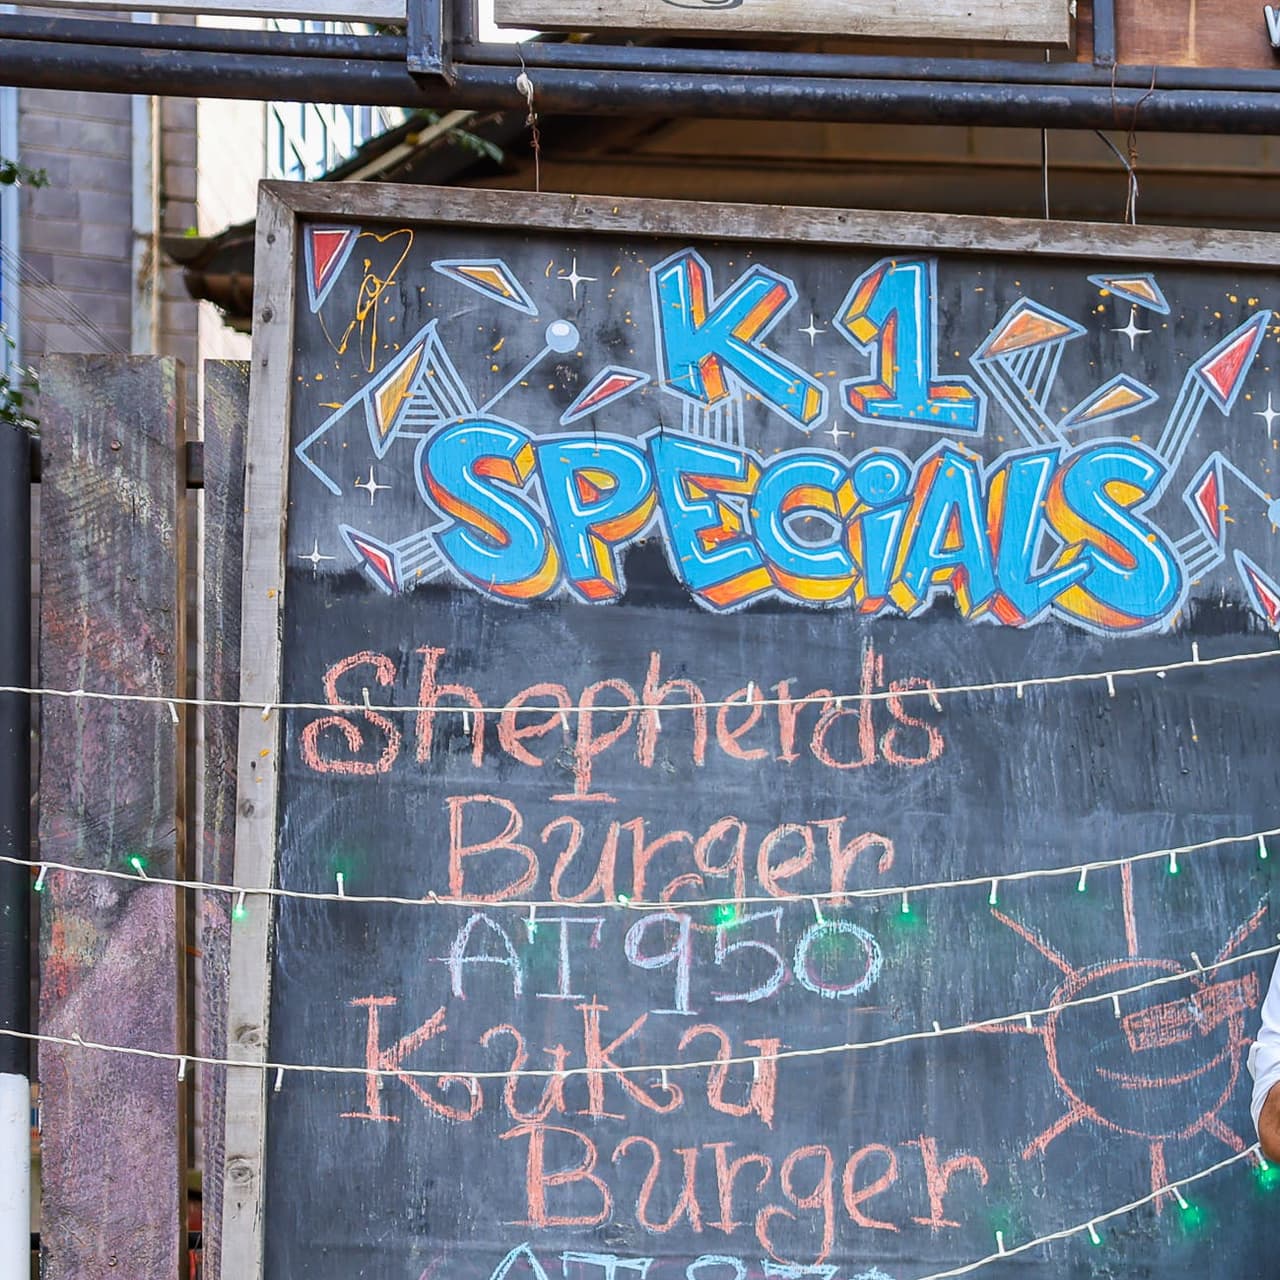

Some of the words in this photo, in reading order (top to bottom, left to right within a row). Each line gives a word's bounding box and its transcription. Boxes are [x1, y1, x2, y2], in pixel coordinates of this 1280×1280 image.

[425, 795, 893, 925] Burger
[625, 908, 882, 1015] 950
[500, 1123, 988, 1265] Burger
